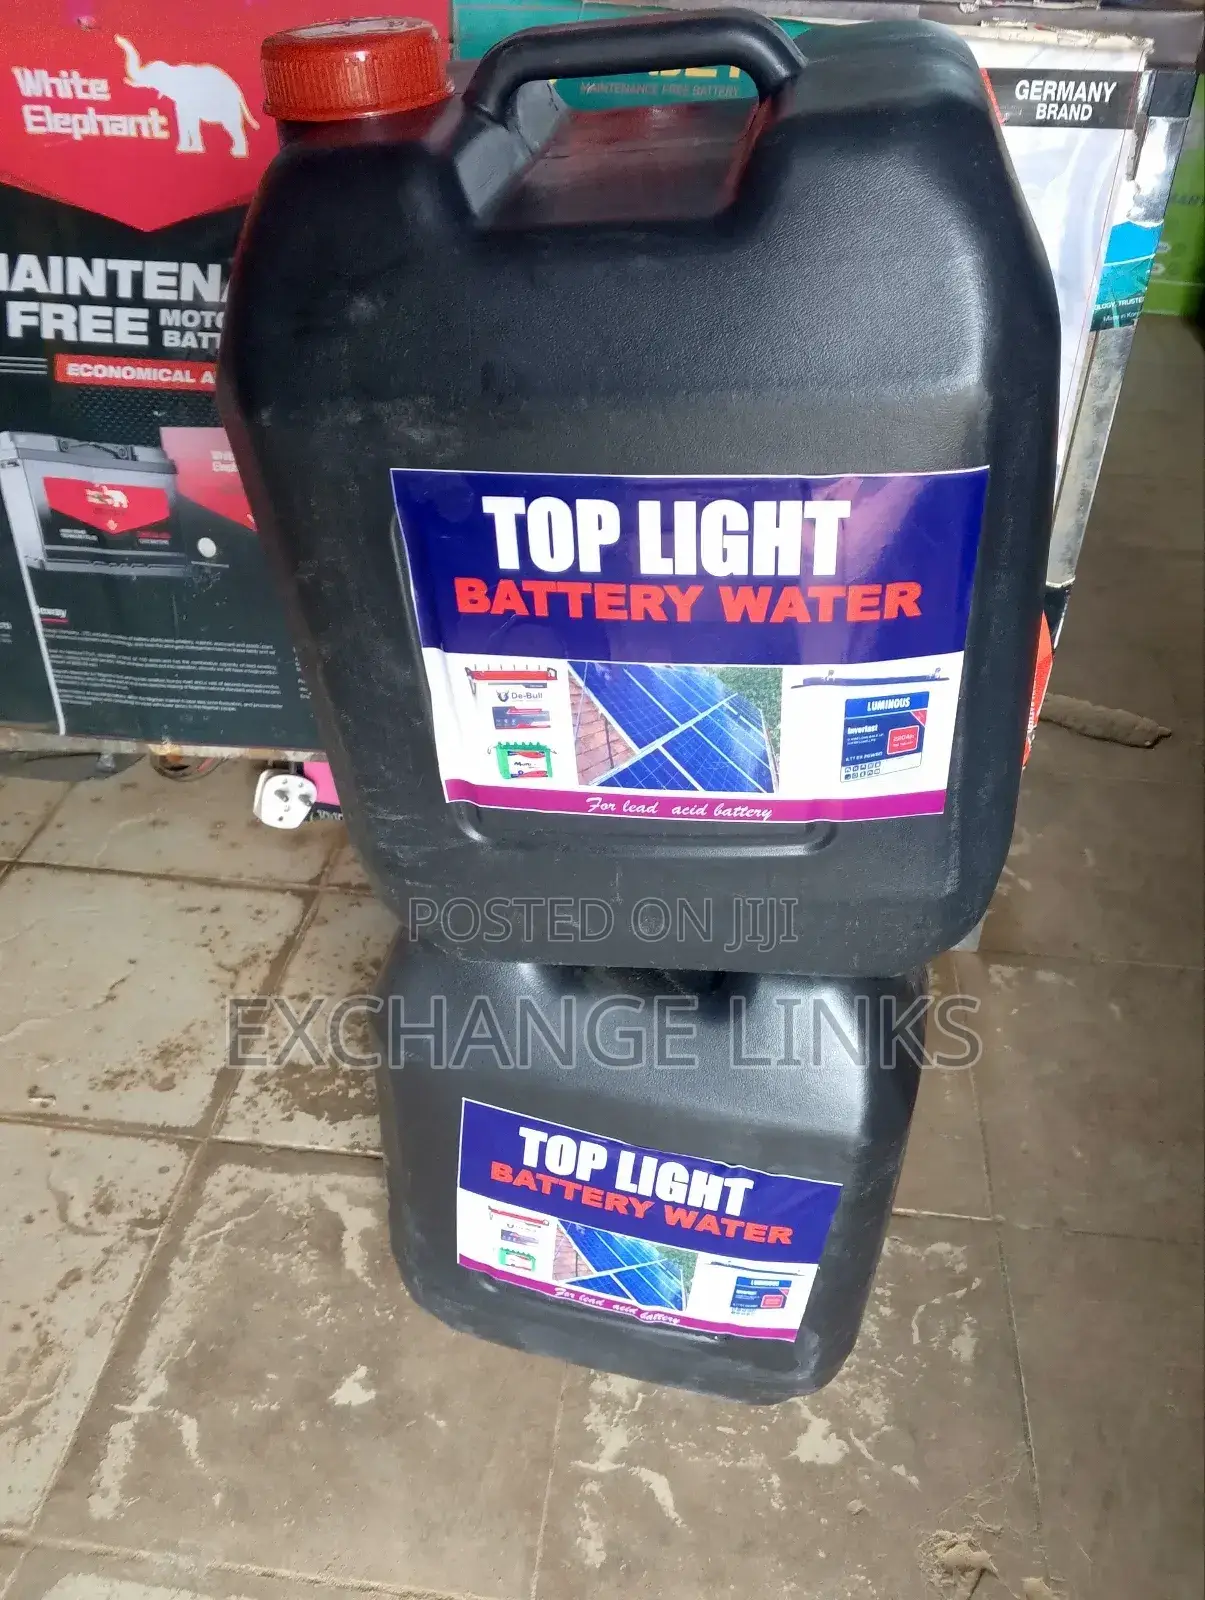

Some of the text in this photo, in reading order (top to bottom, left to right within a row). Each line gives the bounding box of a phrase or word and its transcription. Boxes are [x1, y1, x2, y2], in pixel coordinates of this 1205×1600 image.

[12, 66, 112, 101] White
[662, 84, 690, 96] FREE
[693, 85, 739, 97] BATTERY
[1014, 79, 1117, 103] GERMANY
[21, 104, 170, 140] Elephant
[1035, 103, 1093, 121] BRAND
[0, 253, 230, 303] AINTEN
[6, 301, 150, 346] FREE
[66, 362, 197, 384] ECONOMICAL
[482, 496, 851, 577] TOP LIGHT
[454, 576, 923, 624] BATTERY WATER
[511, 691, 543, 700] De-Bull
[866, 697, 911, 712] LUMINOUS
[585, 796, 773, 822] For lead acid battery
[518, 1126, 755, 1217] TOP LIGHT
[490, 1161, 794, 1245] BATTERY WATER
[554, 1287, 575, 1299] For
